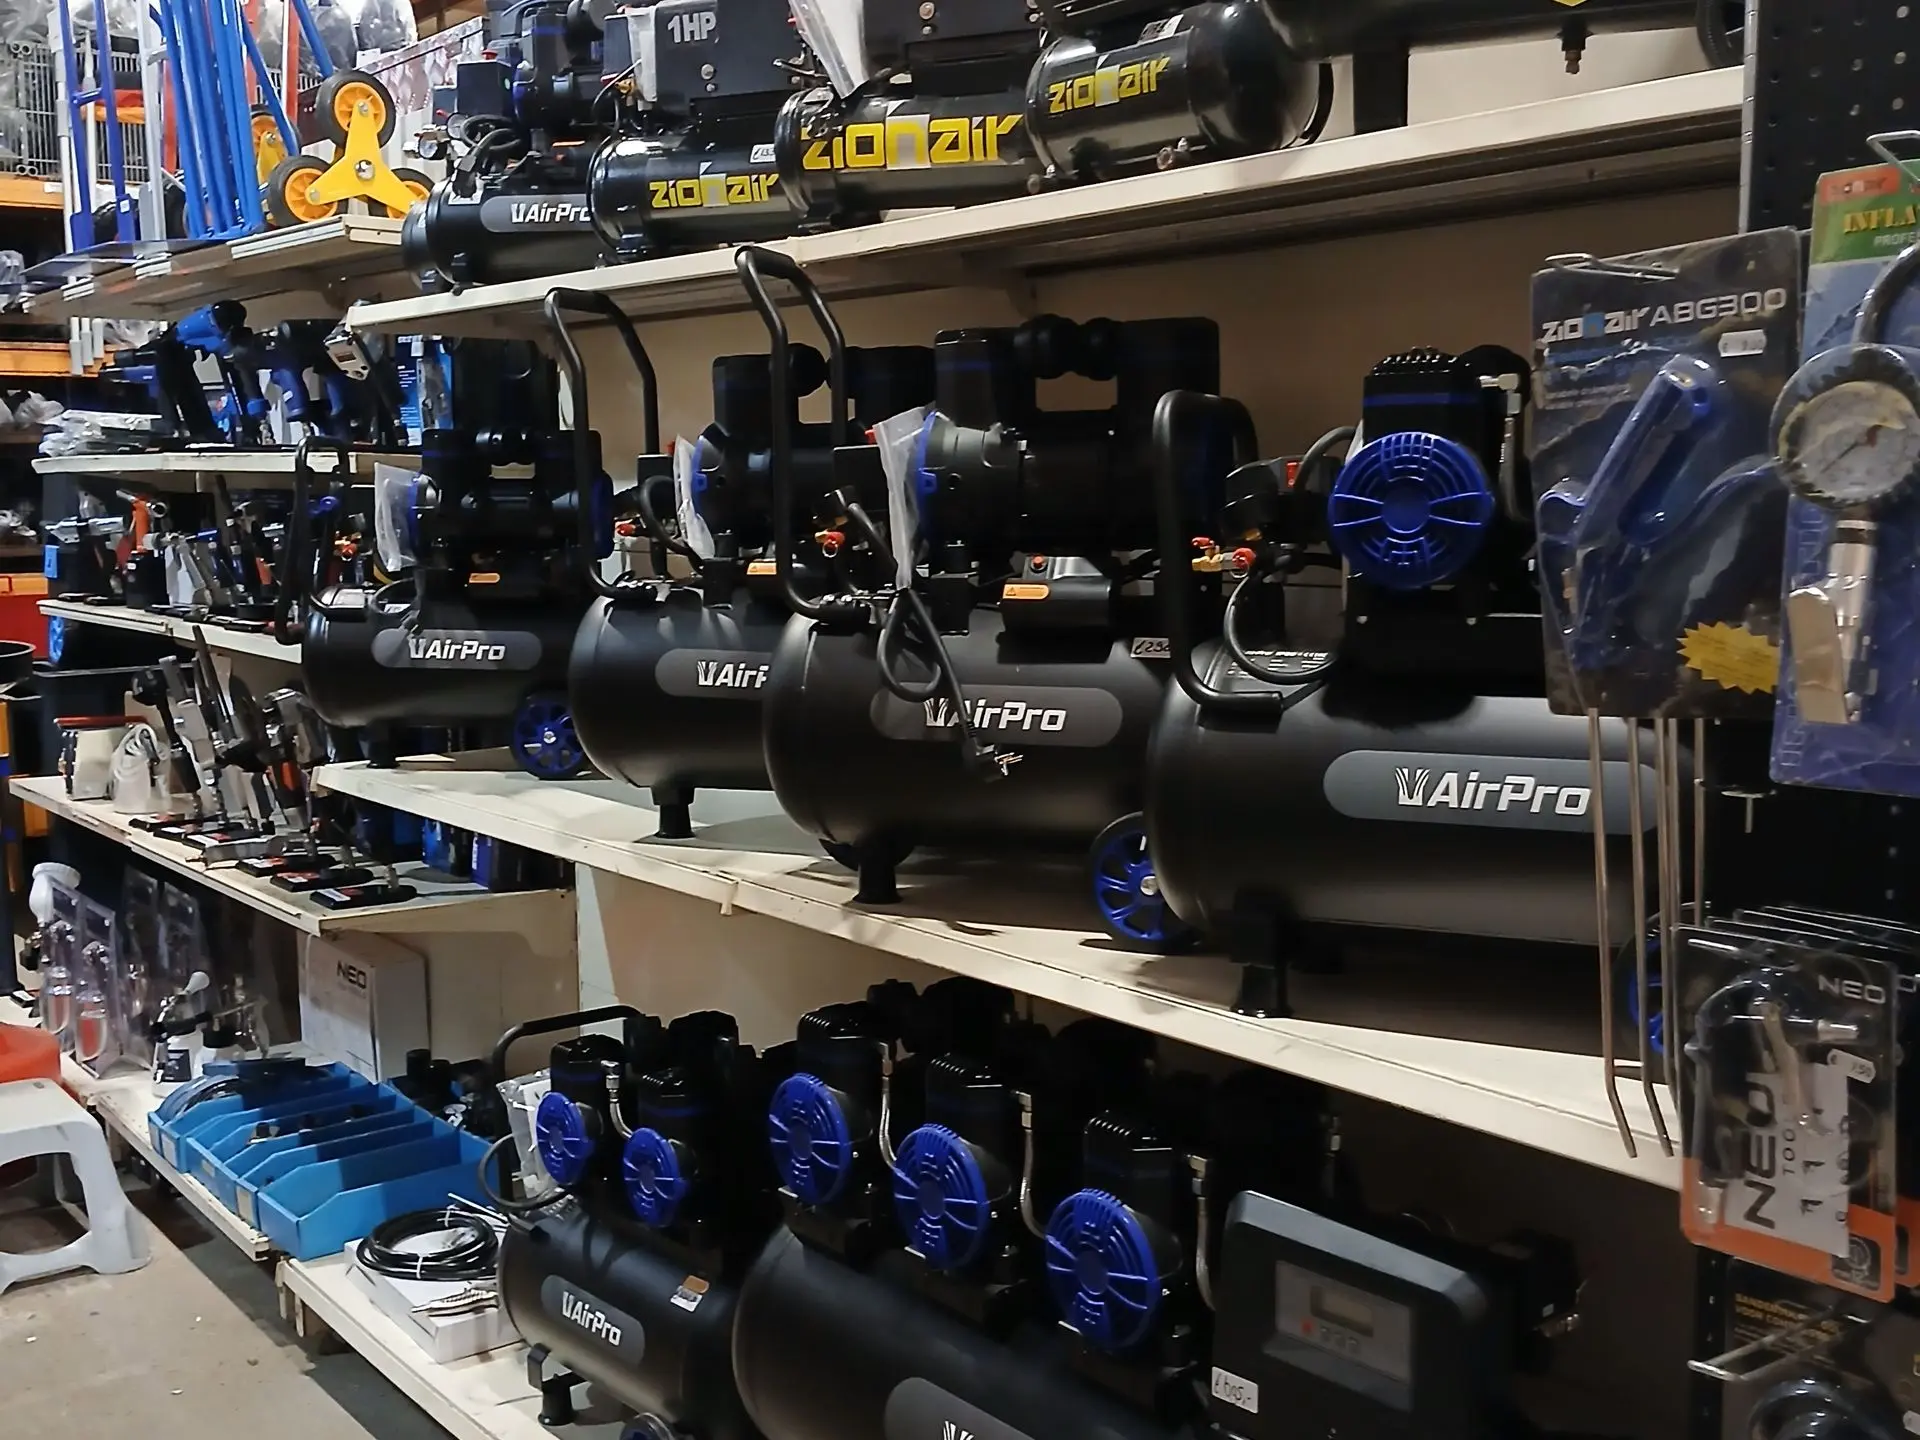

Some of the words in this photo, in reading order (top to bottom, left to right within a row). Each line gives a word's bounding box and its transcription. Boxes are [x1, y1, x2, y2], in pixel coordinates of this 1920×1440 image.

[668, 11, 717, 43] 1HP
[1650, 287, 1787, 328] ABG300
[336, 961, 367, 990] NEO
[1818, 973, 1887, 1005] NEO
